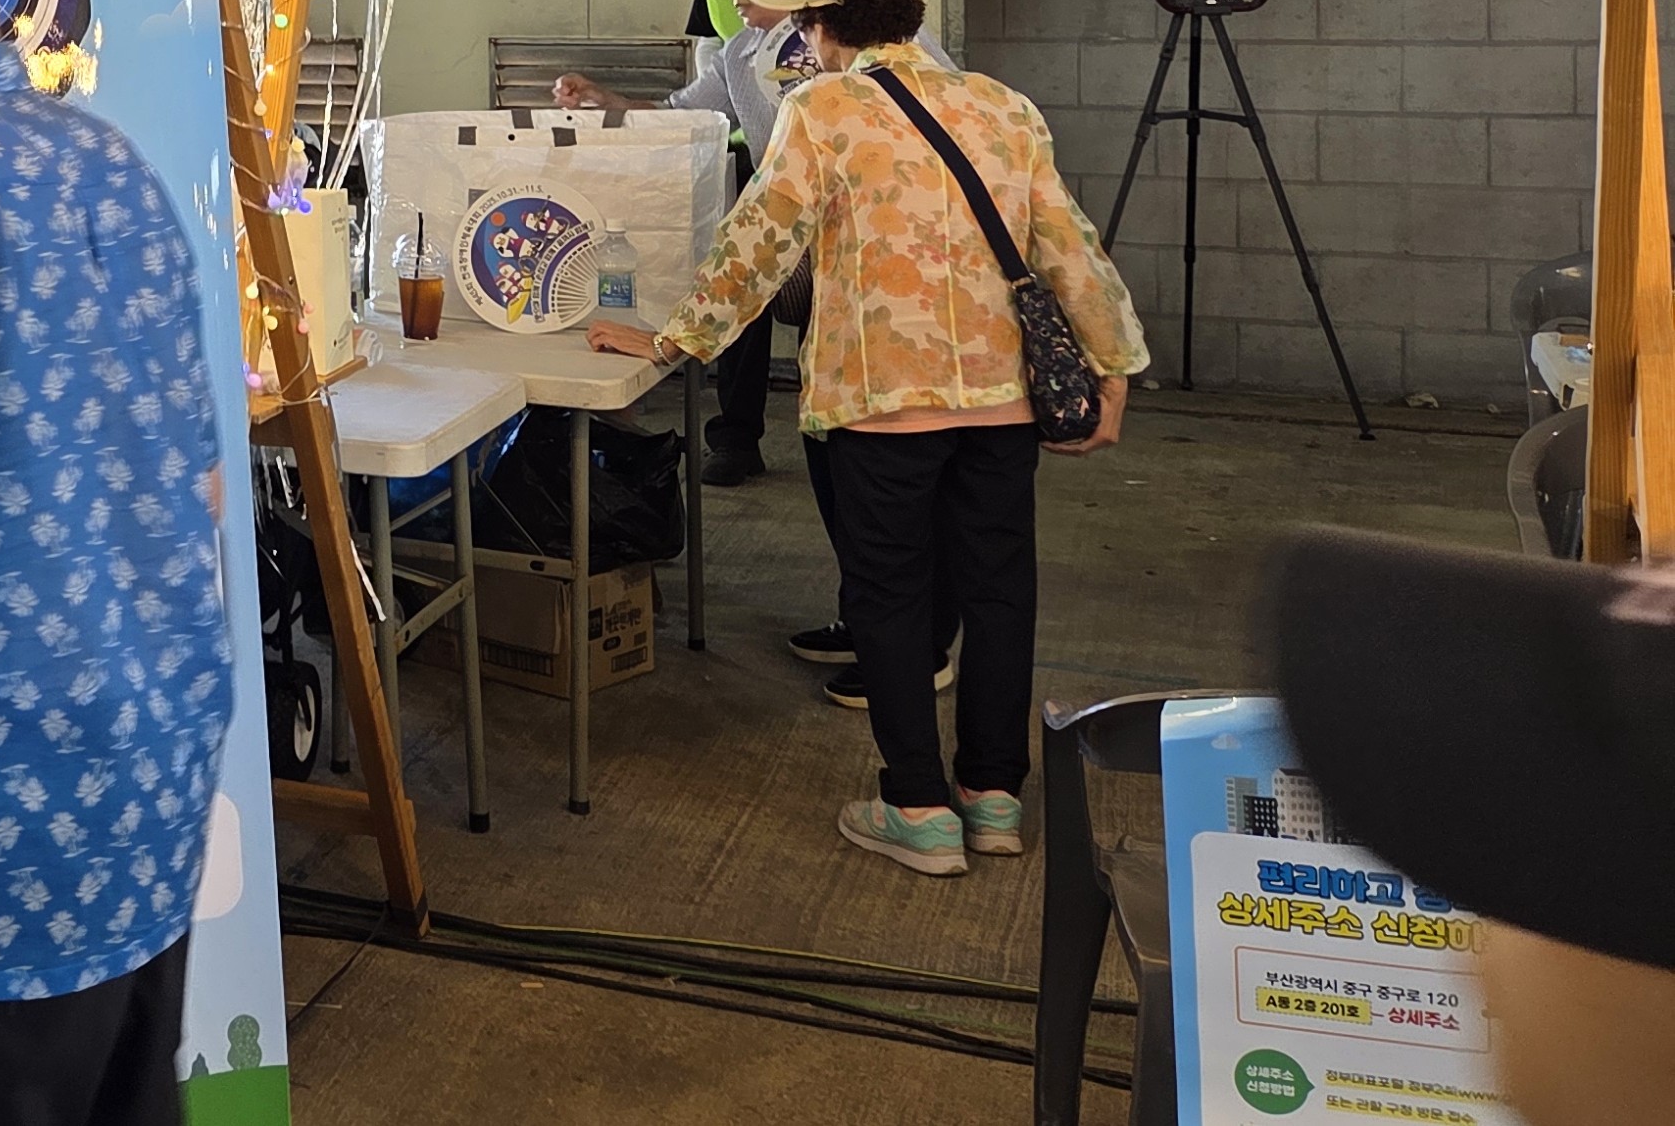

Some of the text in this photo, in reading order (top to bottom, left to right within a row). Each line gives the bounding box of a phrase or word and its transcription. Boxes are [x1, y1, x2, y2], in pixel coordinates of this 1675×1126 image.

[1257, 859, 1406, 908] 편리하고
[1217, 892, 1364, 940] 상세주소
[1265, 972, 1459, 1008] 부산광역시 중구 중구로 120
[1265, 995, 1360, 1018] A동 2층 201호
[1387, 1006, 1461, 1031] 상세주소
[1246, 1064, 1295, 1081] 상세주소
